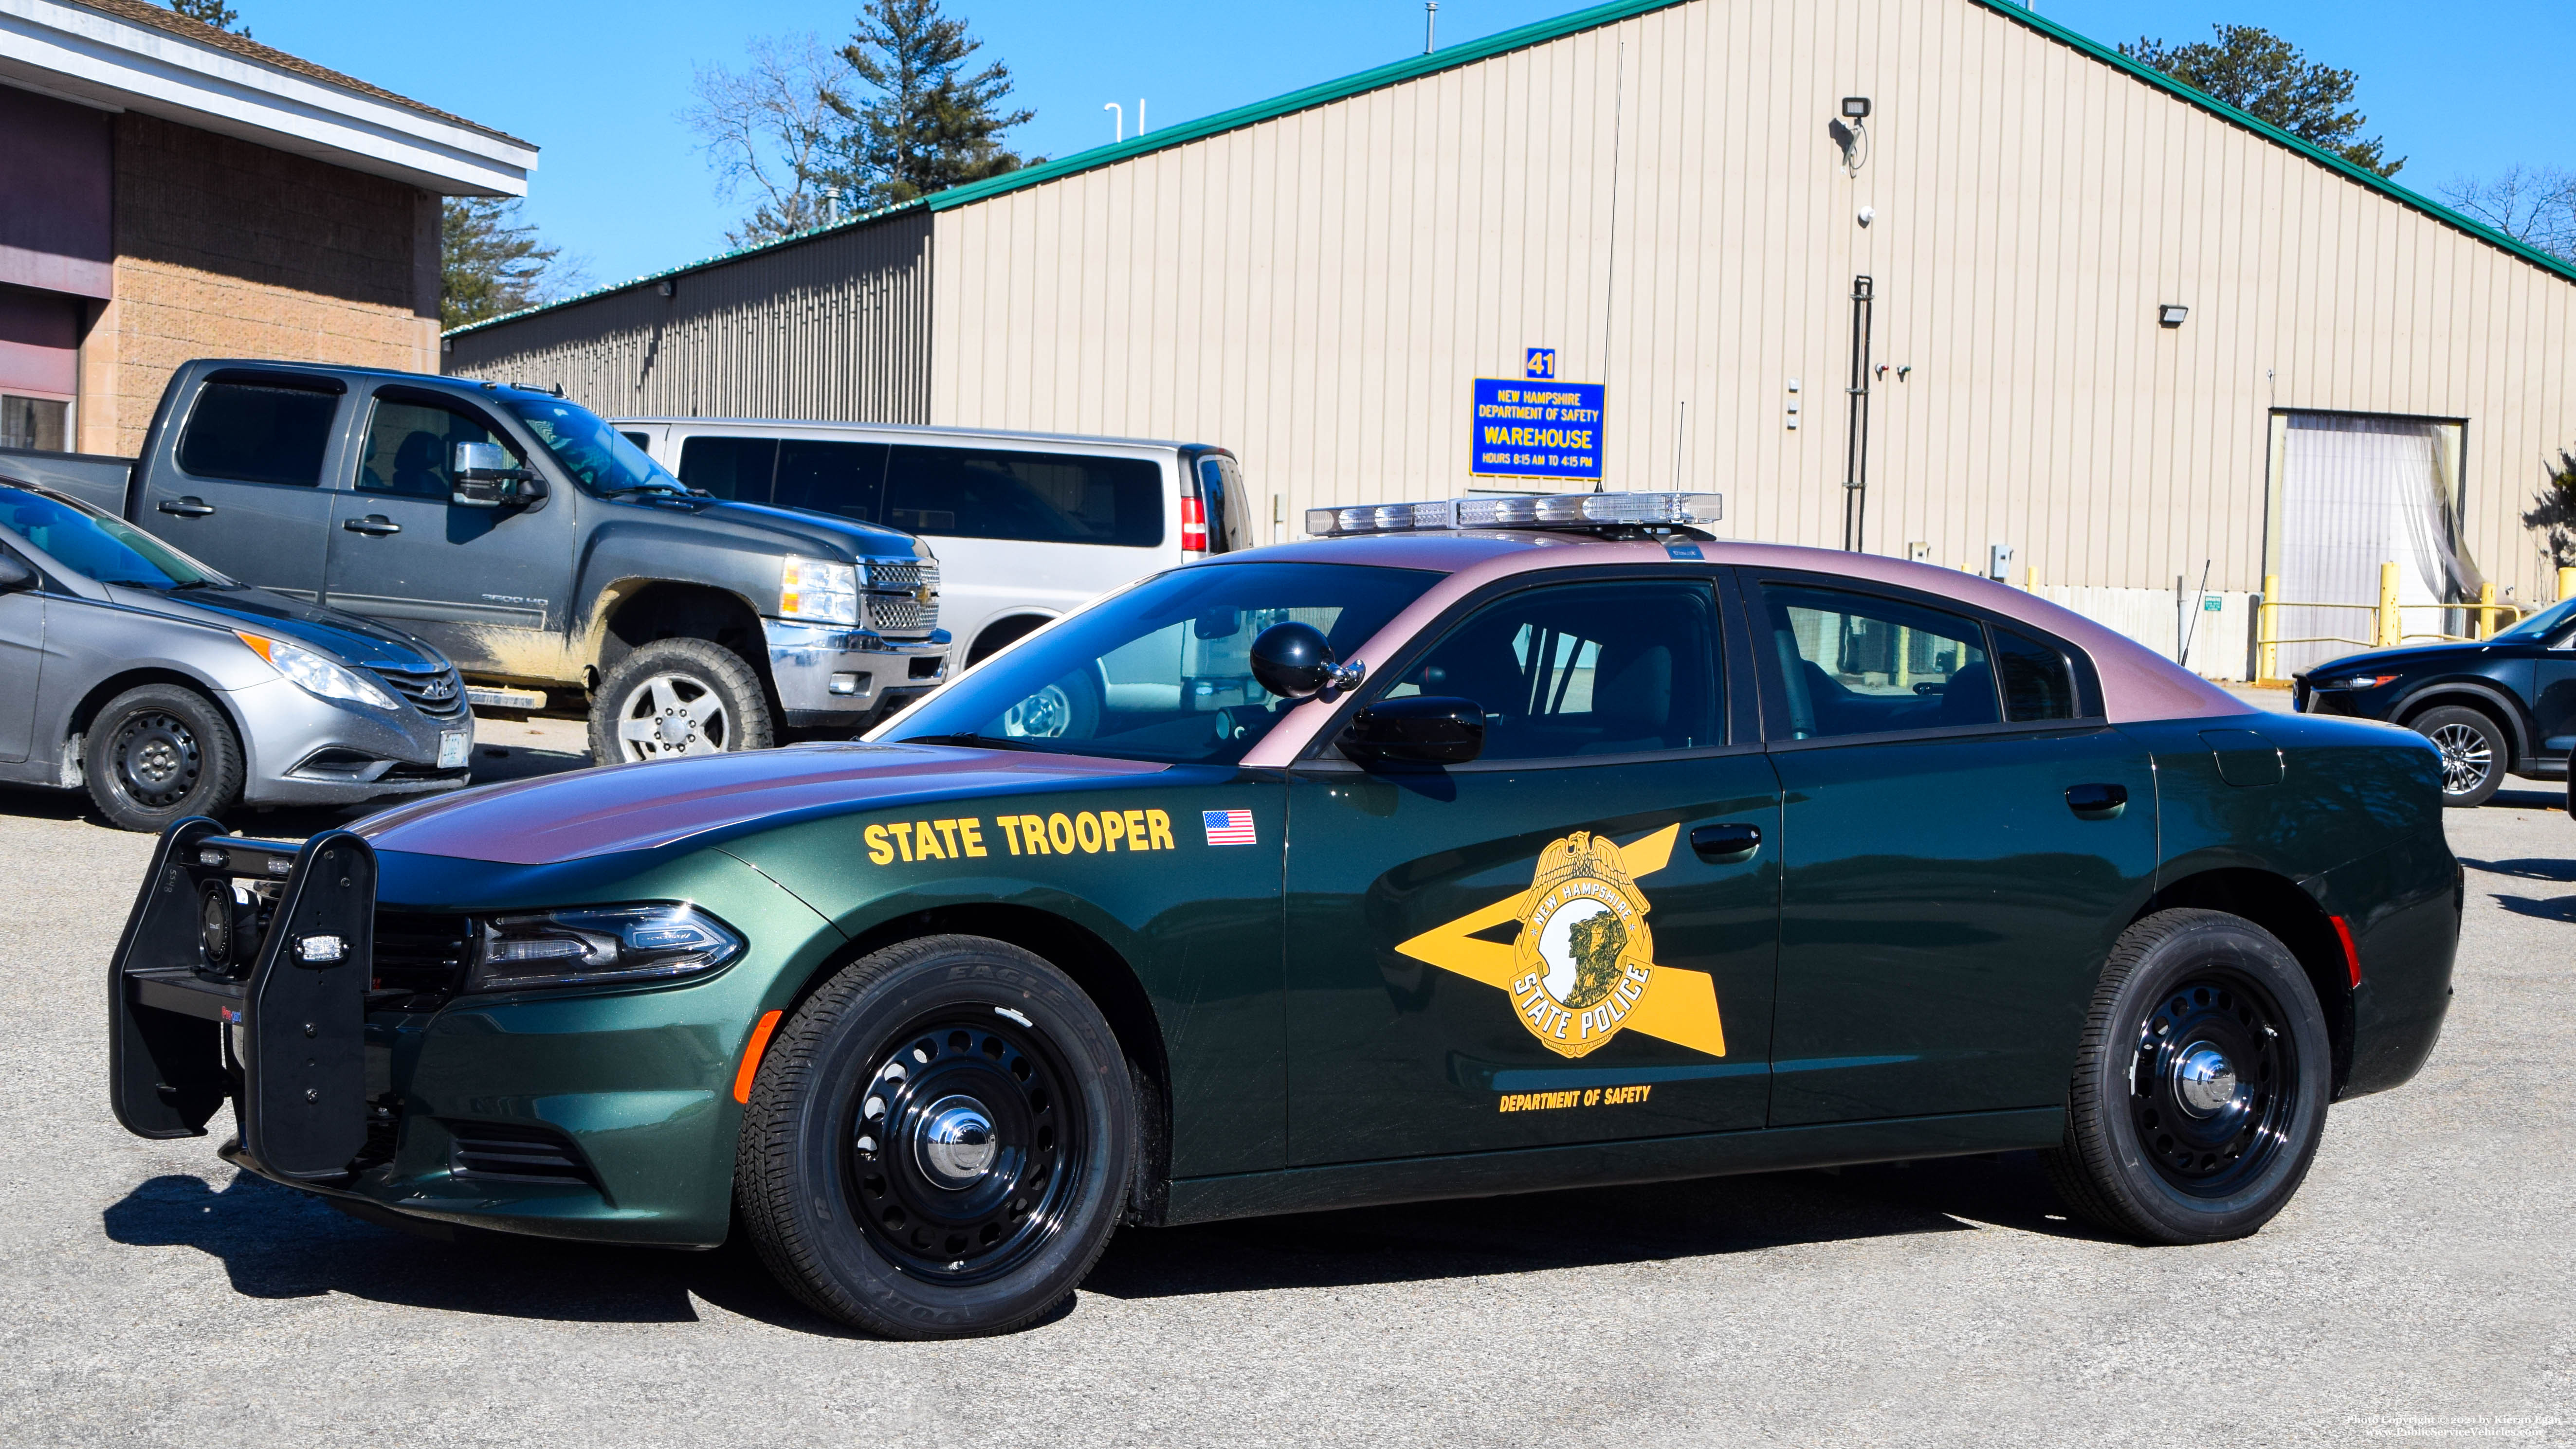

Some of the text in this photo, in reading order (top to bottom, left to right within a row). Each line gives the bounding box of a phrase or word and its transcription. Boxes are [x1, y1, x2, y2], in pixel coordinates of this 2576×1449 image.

[1528, 352, 1553, 375] 41
[1498, 390, 1581, 406] NEW HAMPSHIRE
[1479, 404, 1599, 422] DEPARTMENT OF SAFETY
[1484, 426, 1592, 449] WAREHOUSE
[1482, 452, 1592, 467] HOURS 8:15 AM TO 4:15 PM
[863, 809, 1175, 865] STATE TROOPER
[1534, 882, 1633, 925] NEW HAMPSHIRE
[1514, 963, 1650, 1039] STATE POLICE
[1499, 1086, 1651, 1112] DEPARTMENT OF SAFETY
